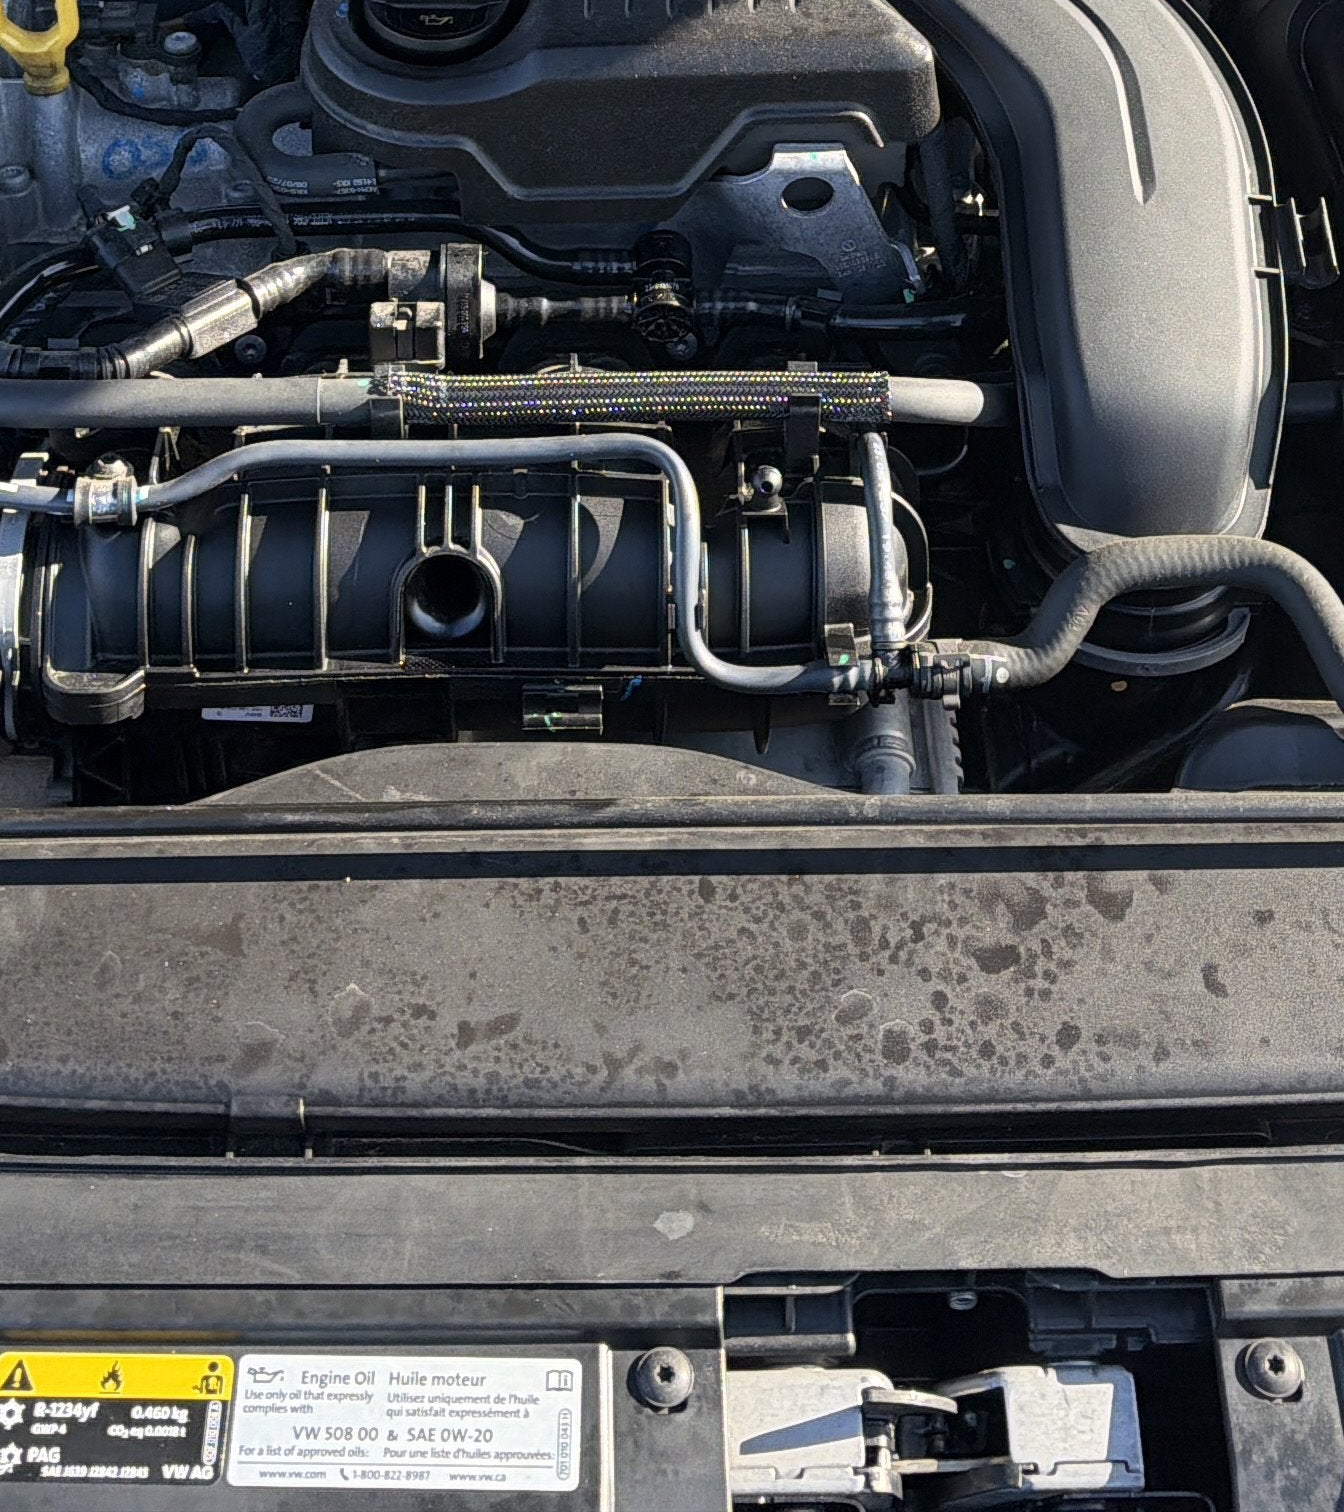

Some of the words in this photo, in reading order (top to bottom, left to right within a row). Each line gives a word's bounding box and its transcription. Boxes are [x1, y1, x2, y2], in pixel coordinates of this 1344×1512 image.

[301, 1370, 351, 1389] Engine
[354, 1370, 376, 1385] Oil
[389, 1371, 427, 1386] Huile
[431, 1373, 487, 1387] moteur
[244, 1389, 263, 1400] Use
[265, 1389, 288, 1402] only
[289, 1389, 302, 1400] oil
[304, 1390, 325, 1401] that
[327, 1391, 374, 1404] expressly
[387, 1392, 425, 1404] Utilisez
[428, 1394, 491, 1407] uniquement
[493, 1393, 506, 1404] de
[32, 1401, 100, 1422] R-1234yf
[171, 1407, 190, 1424] kg
[242, 1403, 288, 1416] complies
[290, 1404, 314, 1414] with
[386, 1407, 403, 1419] qui
[405, 1407, 446, 1417] satisfait
[448, 1408, 521, 1420] expressément
[523, 1408, 530, 1418] à
[293, 1426, 321, 1441] VW
[324, 1426, 354, 1441] 508
[357, 1427, 380, 1442] 00
[386, 1429, 399, 1442] &
[407, 1428, 436, 1443] SAE
[440, 1428, 494, 1443] 0W-20
[26, 1447, 61, 1463] PAG
[238, 1445, 254, 1456] For
[266, 1445, 282, 1456] list
[284, 1445, 296, 1456] of
[297, 1447, 346, 1459] approved
[347, 1446, 370, 1458] oils:
[383, 1447, 408, 1458] Pour
[409, 1450, 429, 1458] une
[430, 1448, 451, 1458] liste
[493, 1449, 556, 1462] approuvées:
[40, 1465, 62, 1477] SAE
[161, 1464, 189, 1479] VW
[190, 1465, 215, 1480] AG
[259, 1470, 327, 1480] www.vw.com
[352, 1470, 431, 1481] 1-800-822-8987
[449, 1471, 507, 1482] www.vw.ca
